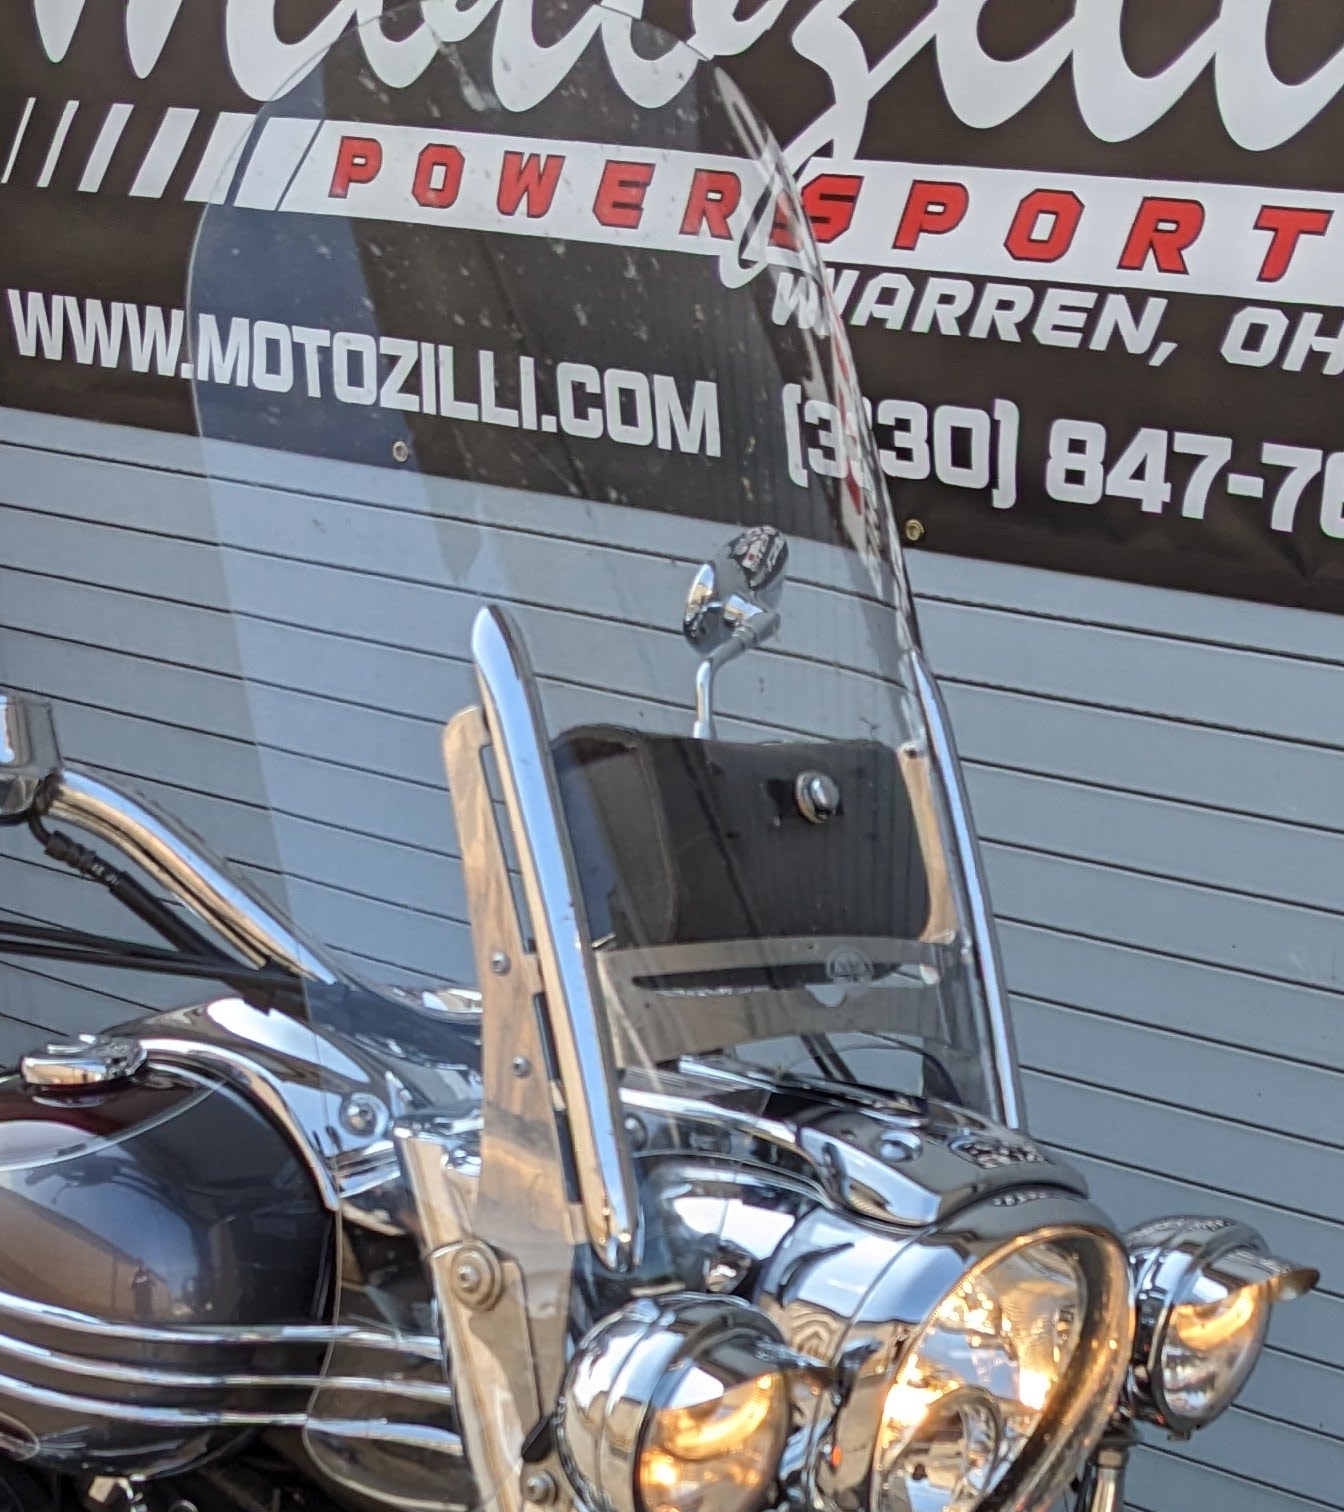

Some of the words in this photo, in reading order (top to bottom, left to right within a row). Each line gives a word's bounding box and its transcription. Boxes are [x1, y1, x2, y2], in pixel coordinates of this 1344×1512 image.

[7, 288, 722, 458] WWW.MOTOZILLI.COM
[771, 267, 1178, 367] WARREN,
[782, 382, 1020, 510] (330)
